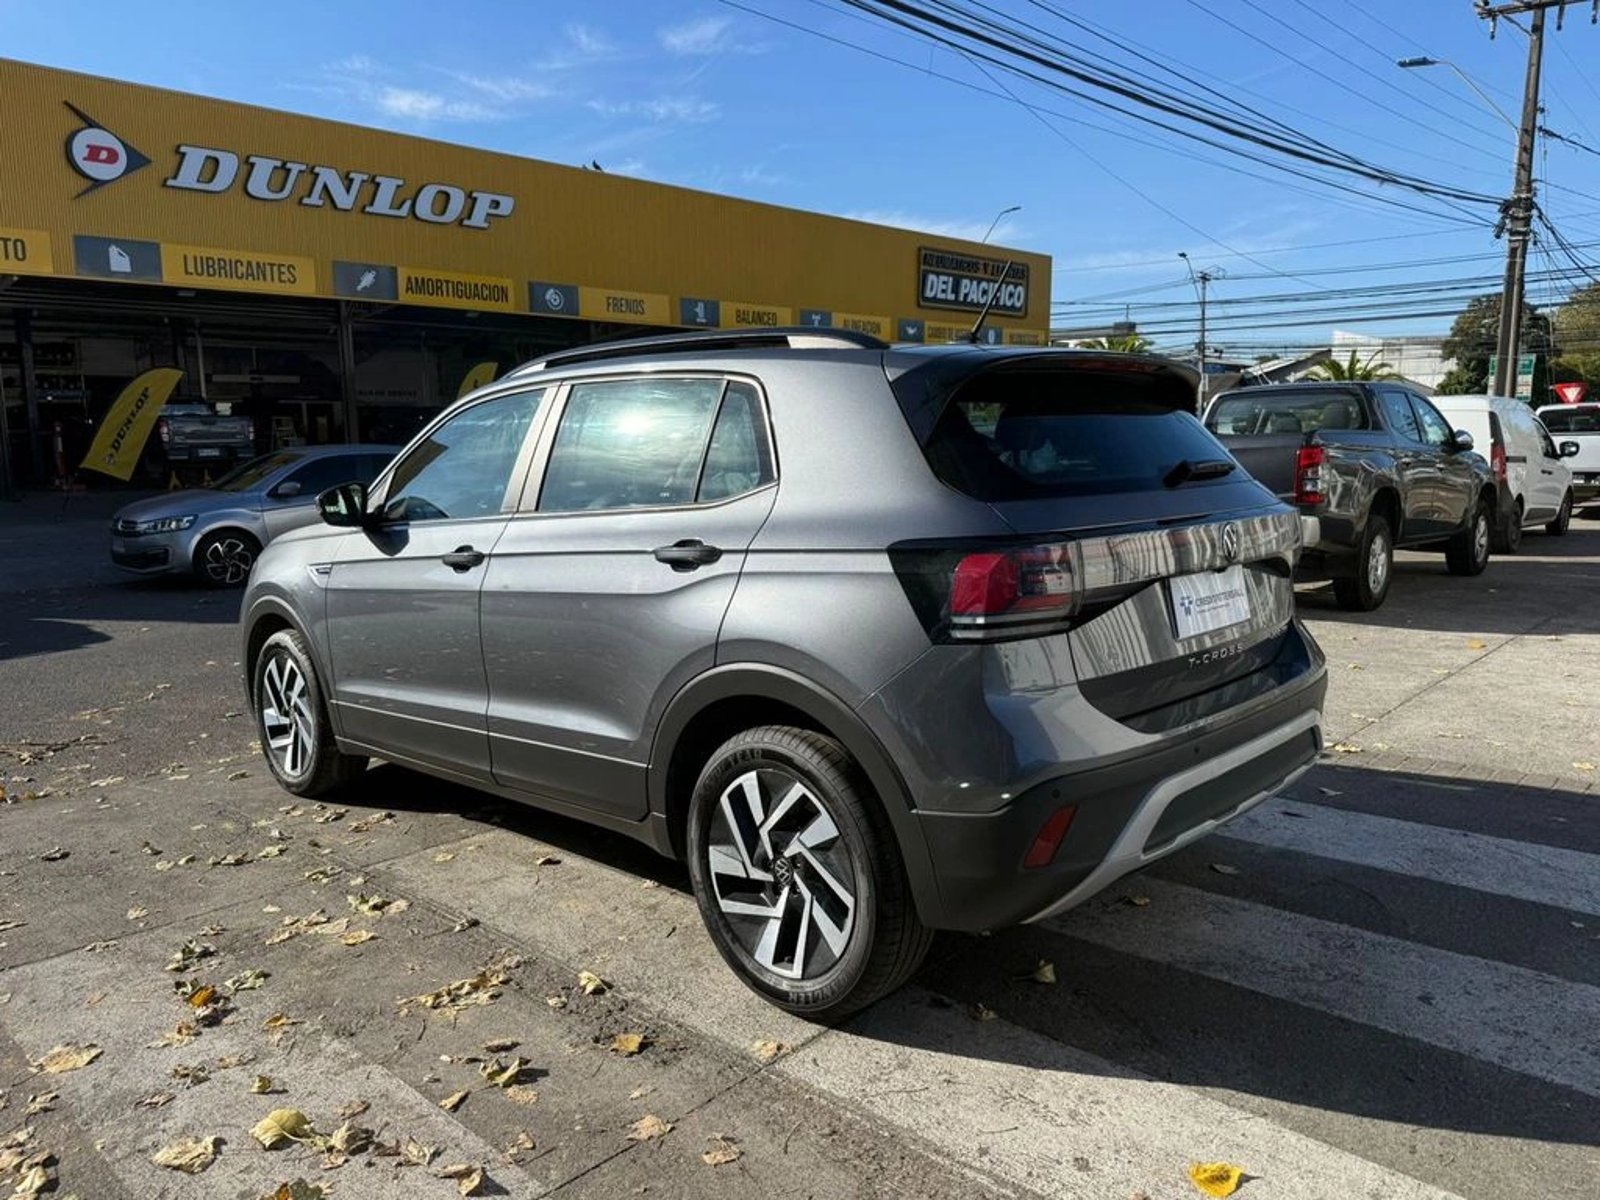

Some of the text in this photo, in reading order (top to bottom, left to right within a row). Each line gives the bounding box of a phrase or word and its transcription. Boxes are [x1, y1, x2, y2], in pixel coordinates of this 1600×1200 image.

[83, 143, 119, 165] D
[163, 144, 515, 229] DUNLOP
[183, 254, 297, 284] LUBRICANTES
[405, 275, 509, 303] AMORTIGUACION
[924, 273, 955, 301] DEL
[606, 296, 645, 315] FRENOS
[736, 309, 777, 326] BALANCEO
[112, 386, 149, 453] DUNLOP
[1188, 642, 1244, 669] T-CROSS
